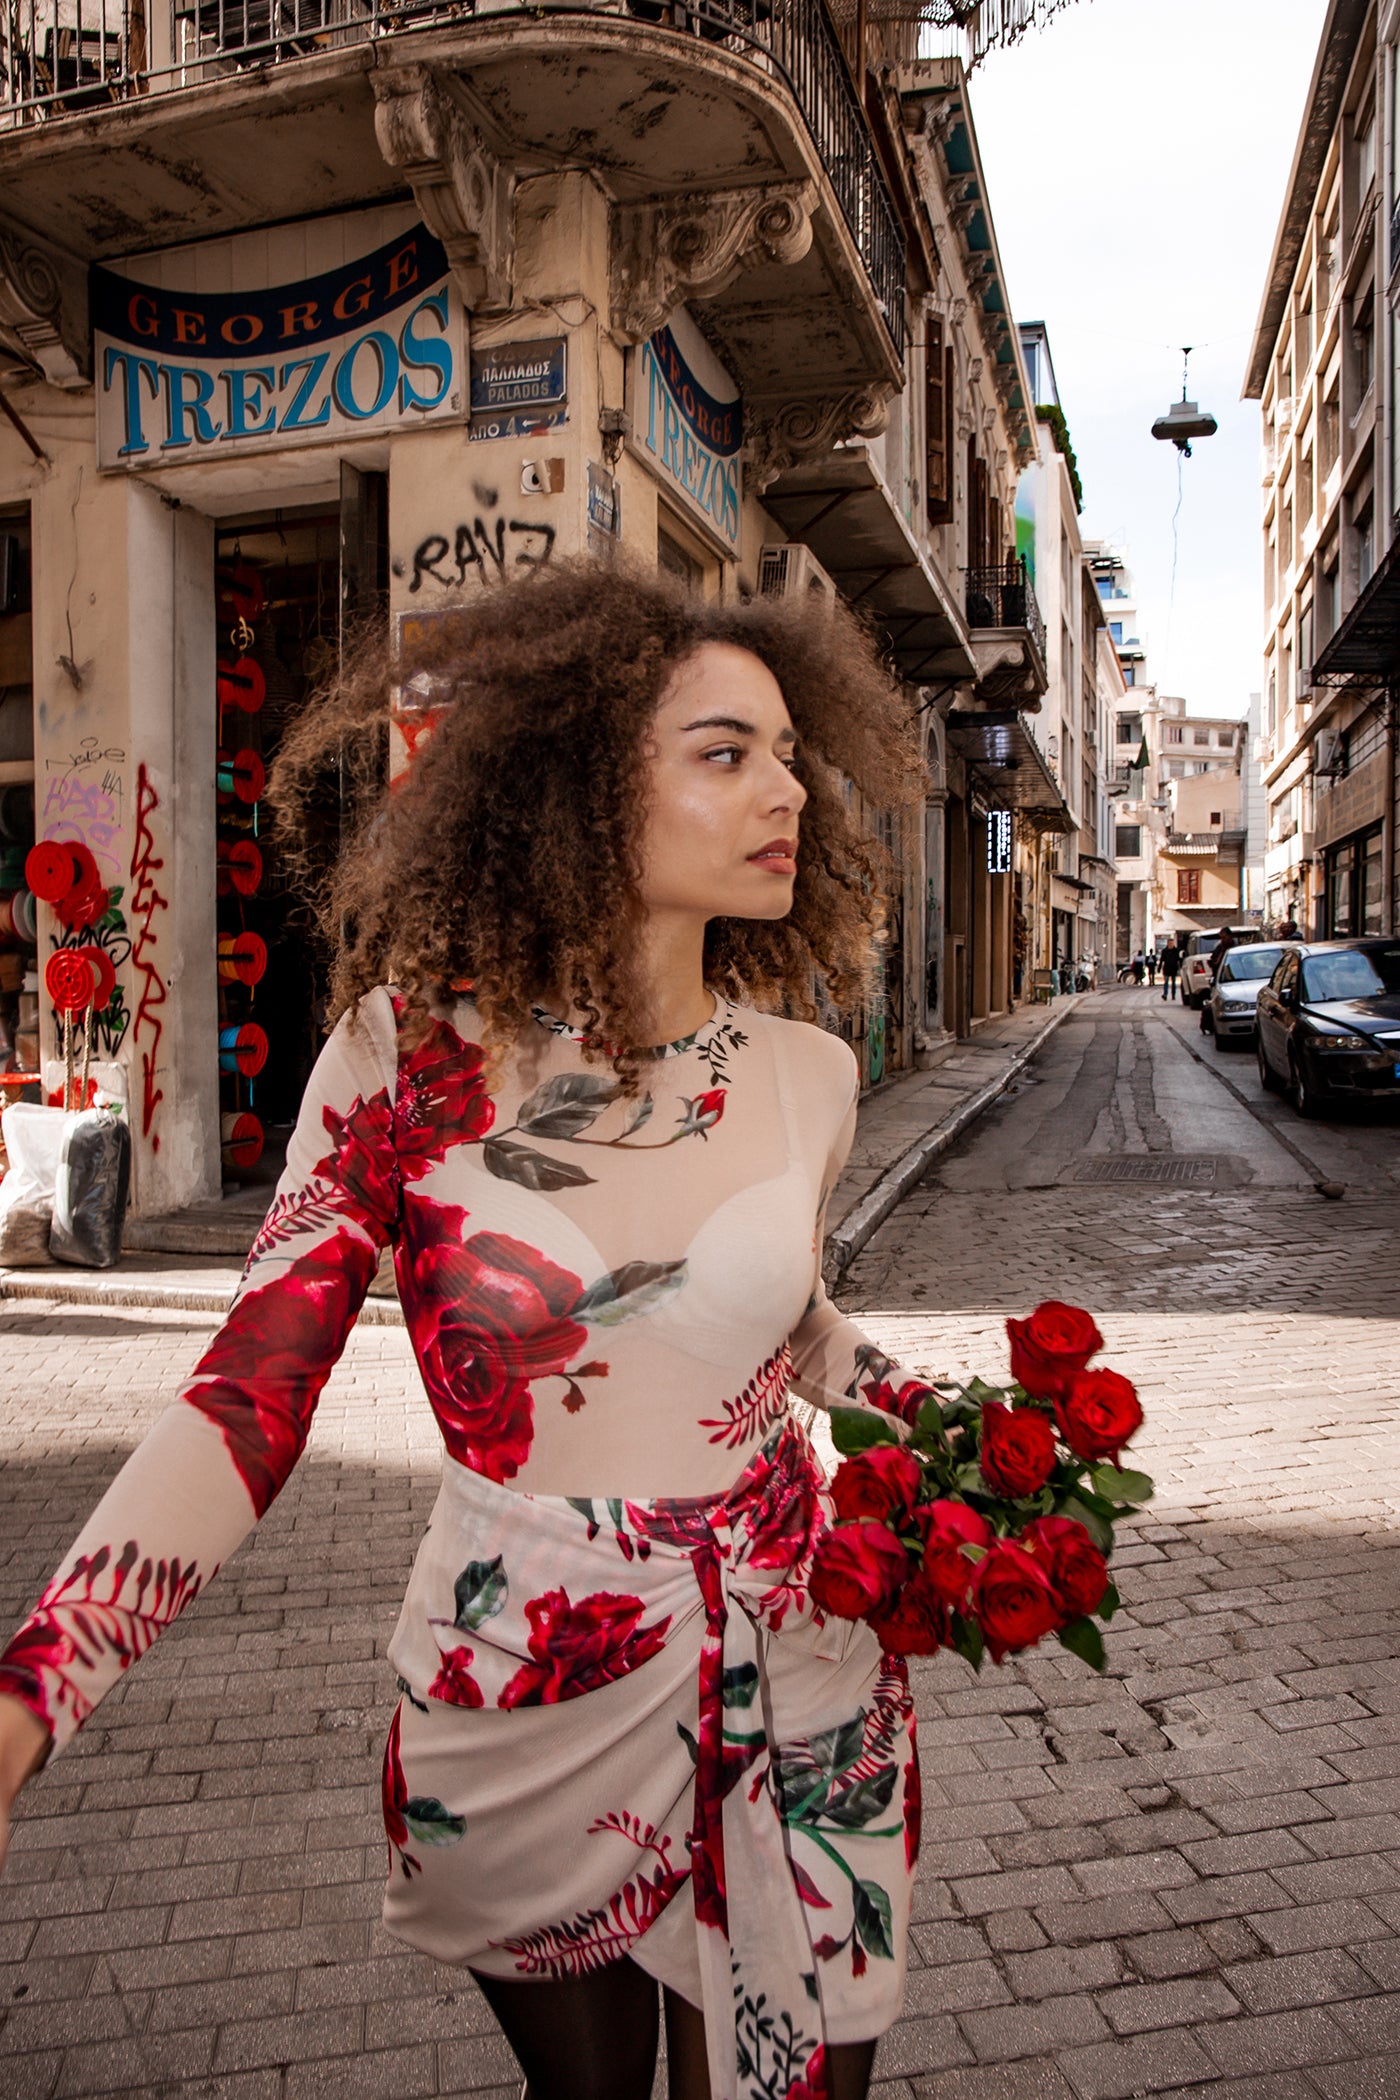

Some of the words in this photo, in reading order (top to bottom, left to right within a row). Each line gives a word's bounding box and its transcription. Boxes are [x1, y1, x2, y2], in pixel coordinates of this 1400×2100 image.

[128, 240, 420, 346] GEORGE
[104, 285, 453, 457] TREZOS
[482, 361, 551, 383] ΠΑΛΛΑΔΟΣ
[488, 382, 550, 403] PALADOS
[655, 330, 733, 446] GEORGE
[469, 423, 500, 440] ΑΠΟ
[505, 416, 518, 437] 4
[548, 413, 558, 428] 2
[642, 340, 739, 543] TREZOS
